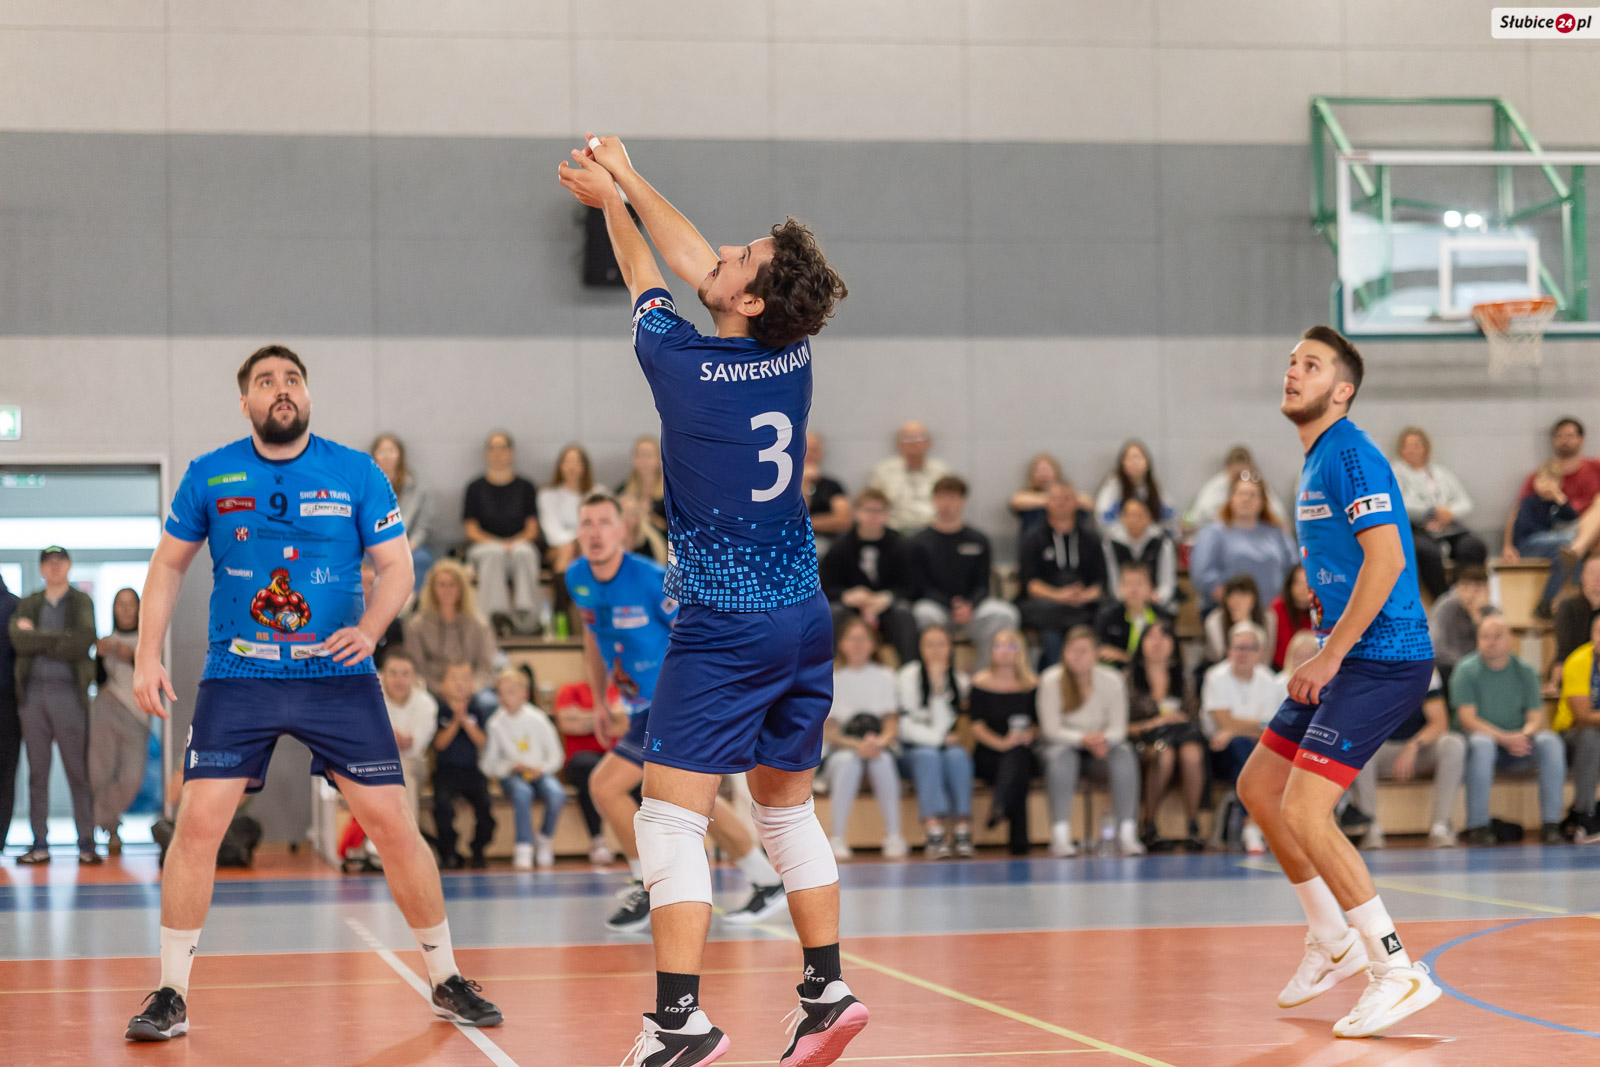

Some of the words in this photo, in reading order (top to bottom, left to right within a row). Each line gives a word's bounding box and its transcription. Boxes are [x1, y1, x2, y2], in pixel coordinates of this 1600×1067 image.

[700, 344, 810, 382] SAWERWAIN
[750, 411, 793, 502] 3
[269, 492, 288, 517] 9
